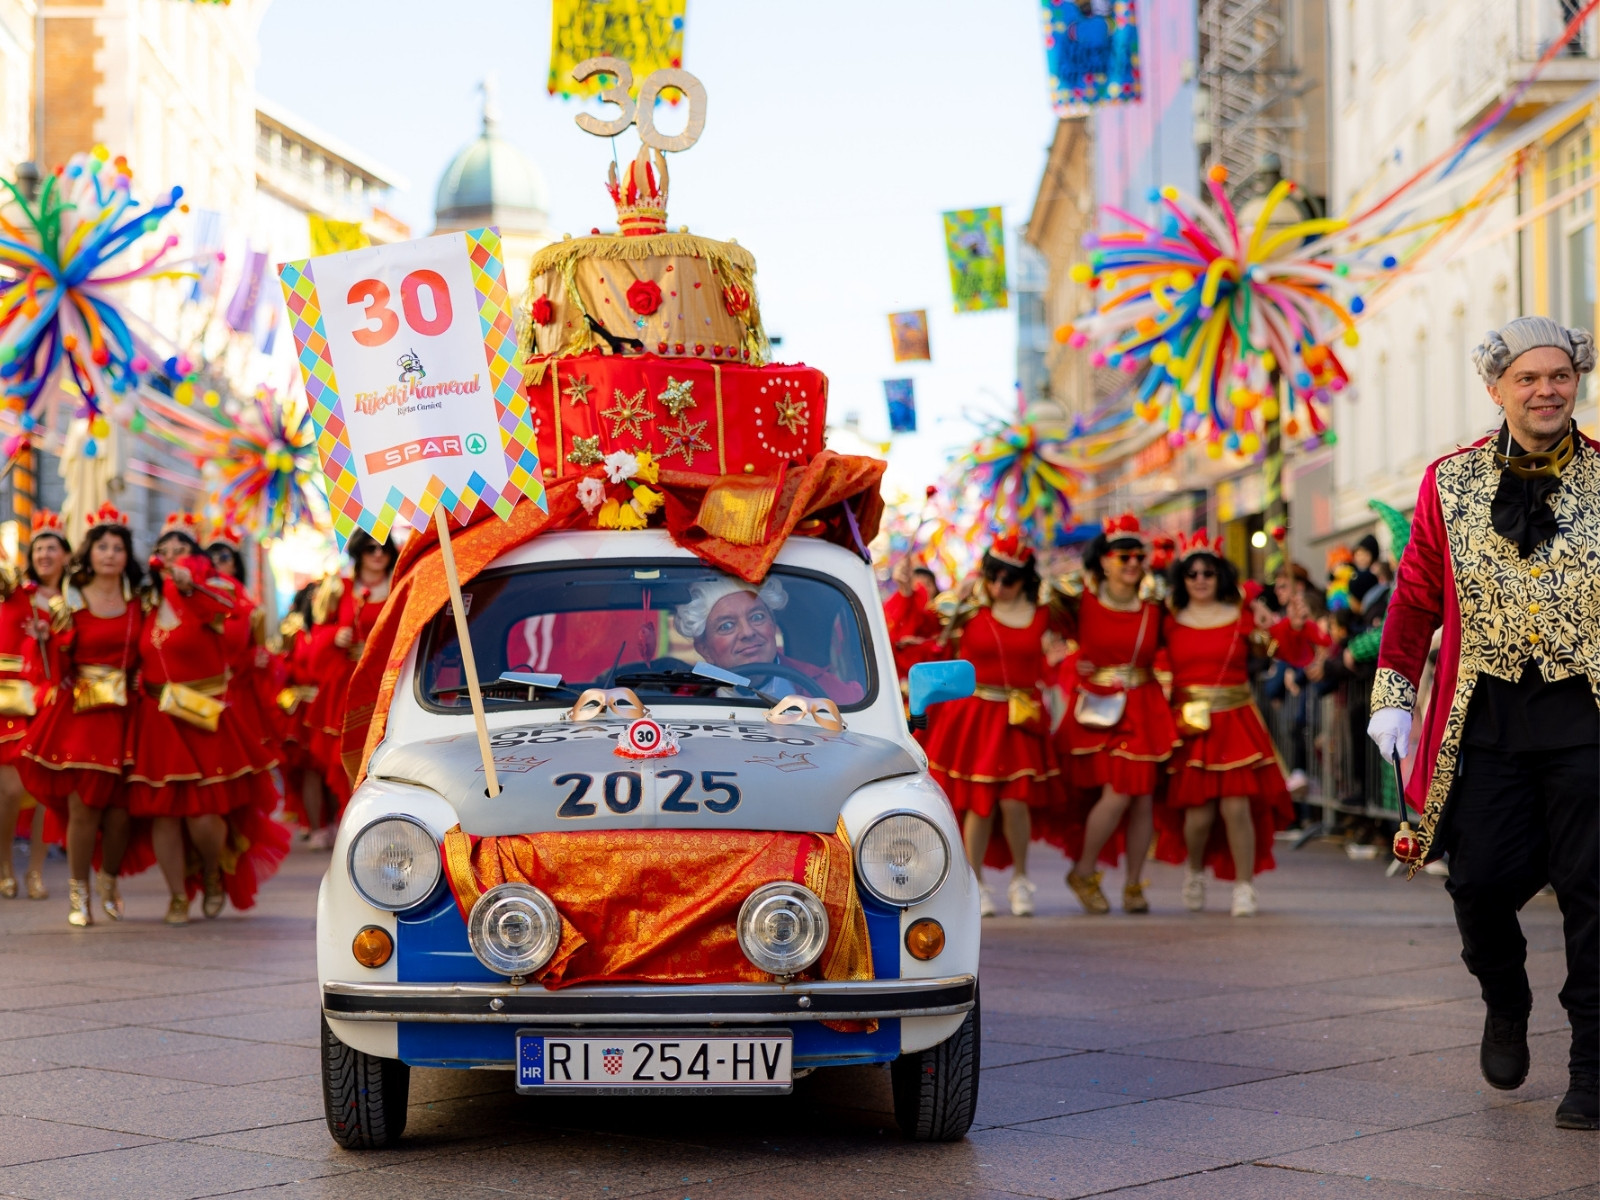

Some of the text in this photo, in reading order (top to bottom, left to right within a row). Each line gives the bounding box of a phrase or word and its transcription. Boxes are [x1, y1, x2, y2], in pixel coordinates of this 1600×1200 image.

[572, 56, 707, 152] 30
[347, 269, 453, 347] 30
[354, 384, 409, 415] Riječki
[384, 439, 460, 466] SPAR
[637, 730, 654, 743] 30
[553, 769, 742, 818] 2025
[522, 1066, 542, 1079] HR
[548, 1042, 783, 1081] RI 254-HV
[596, 1087, 713, 1096] EUROHERC
